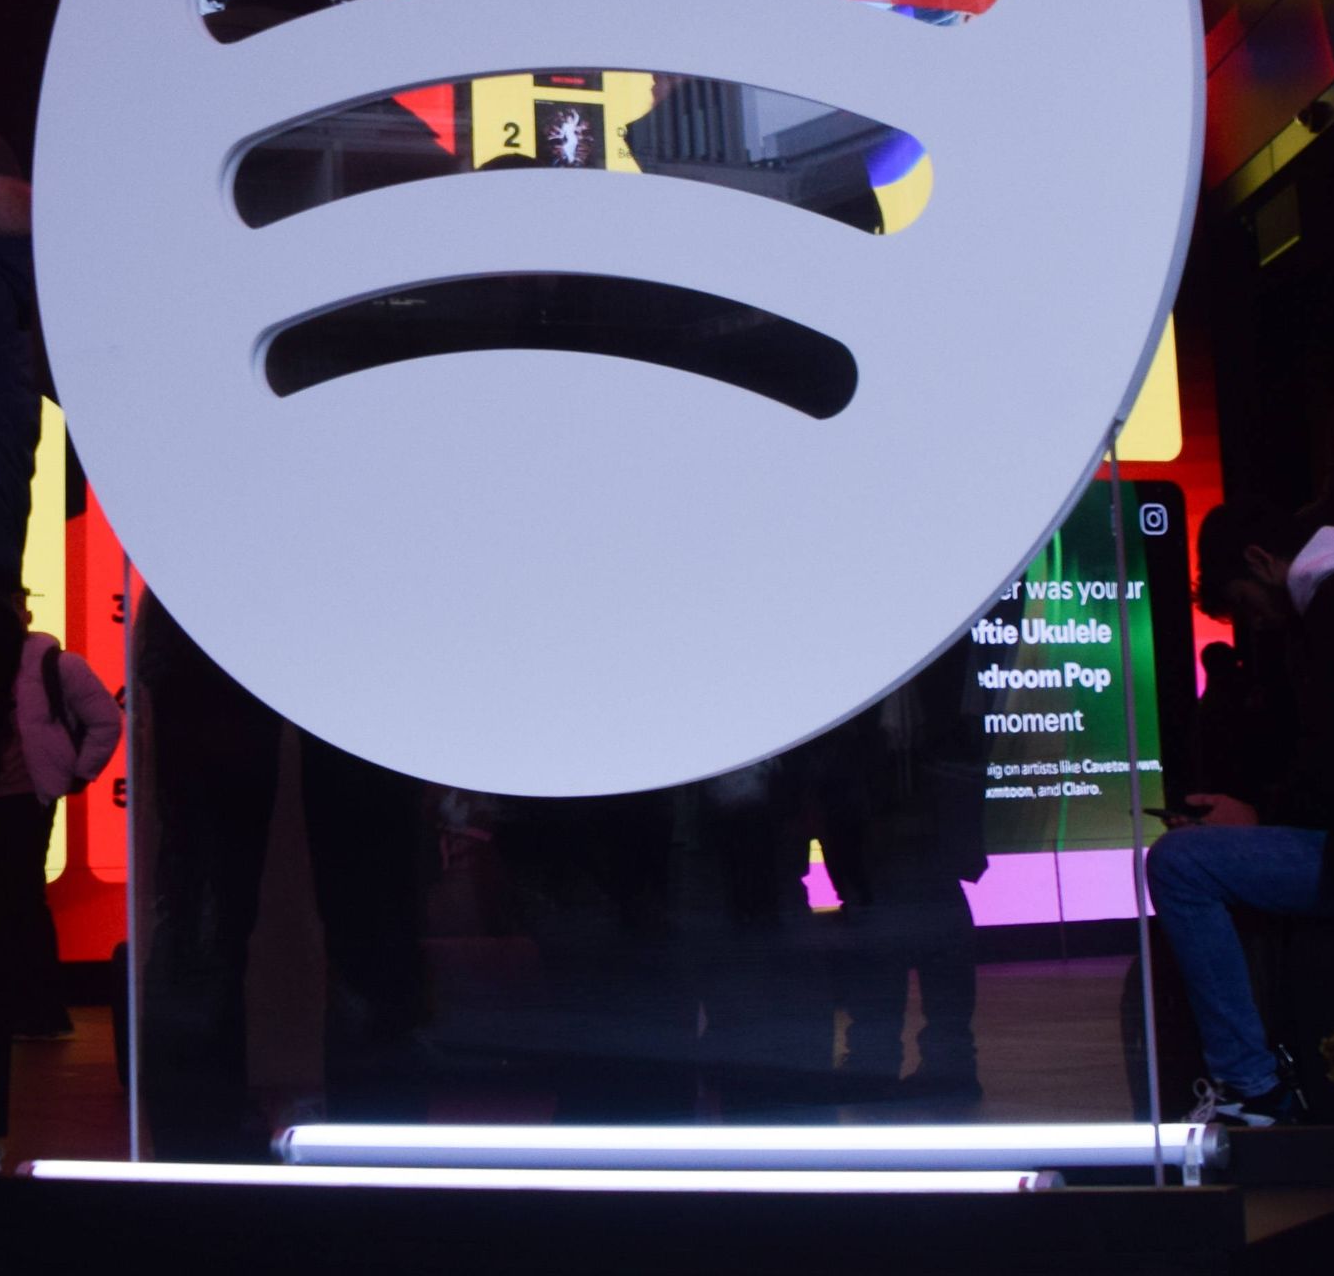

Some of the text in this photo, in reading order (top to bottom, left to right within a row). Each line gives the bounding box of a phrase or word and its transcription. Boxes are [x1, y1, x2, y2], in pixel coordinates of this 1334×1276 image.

[502, 121, 521, 149] 2
[1020, 617, 1112, 645] Ukulele
[1063, 661, 1111, 693] Pop
[984, 709, 1085, 733] moment
